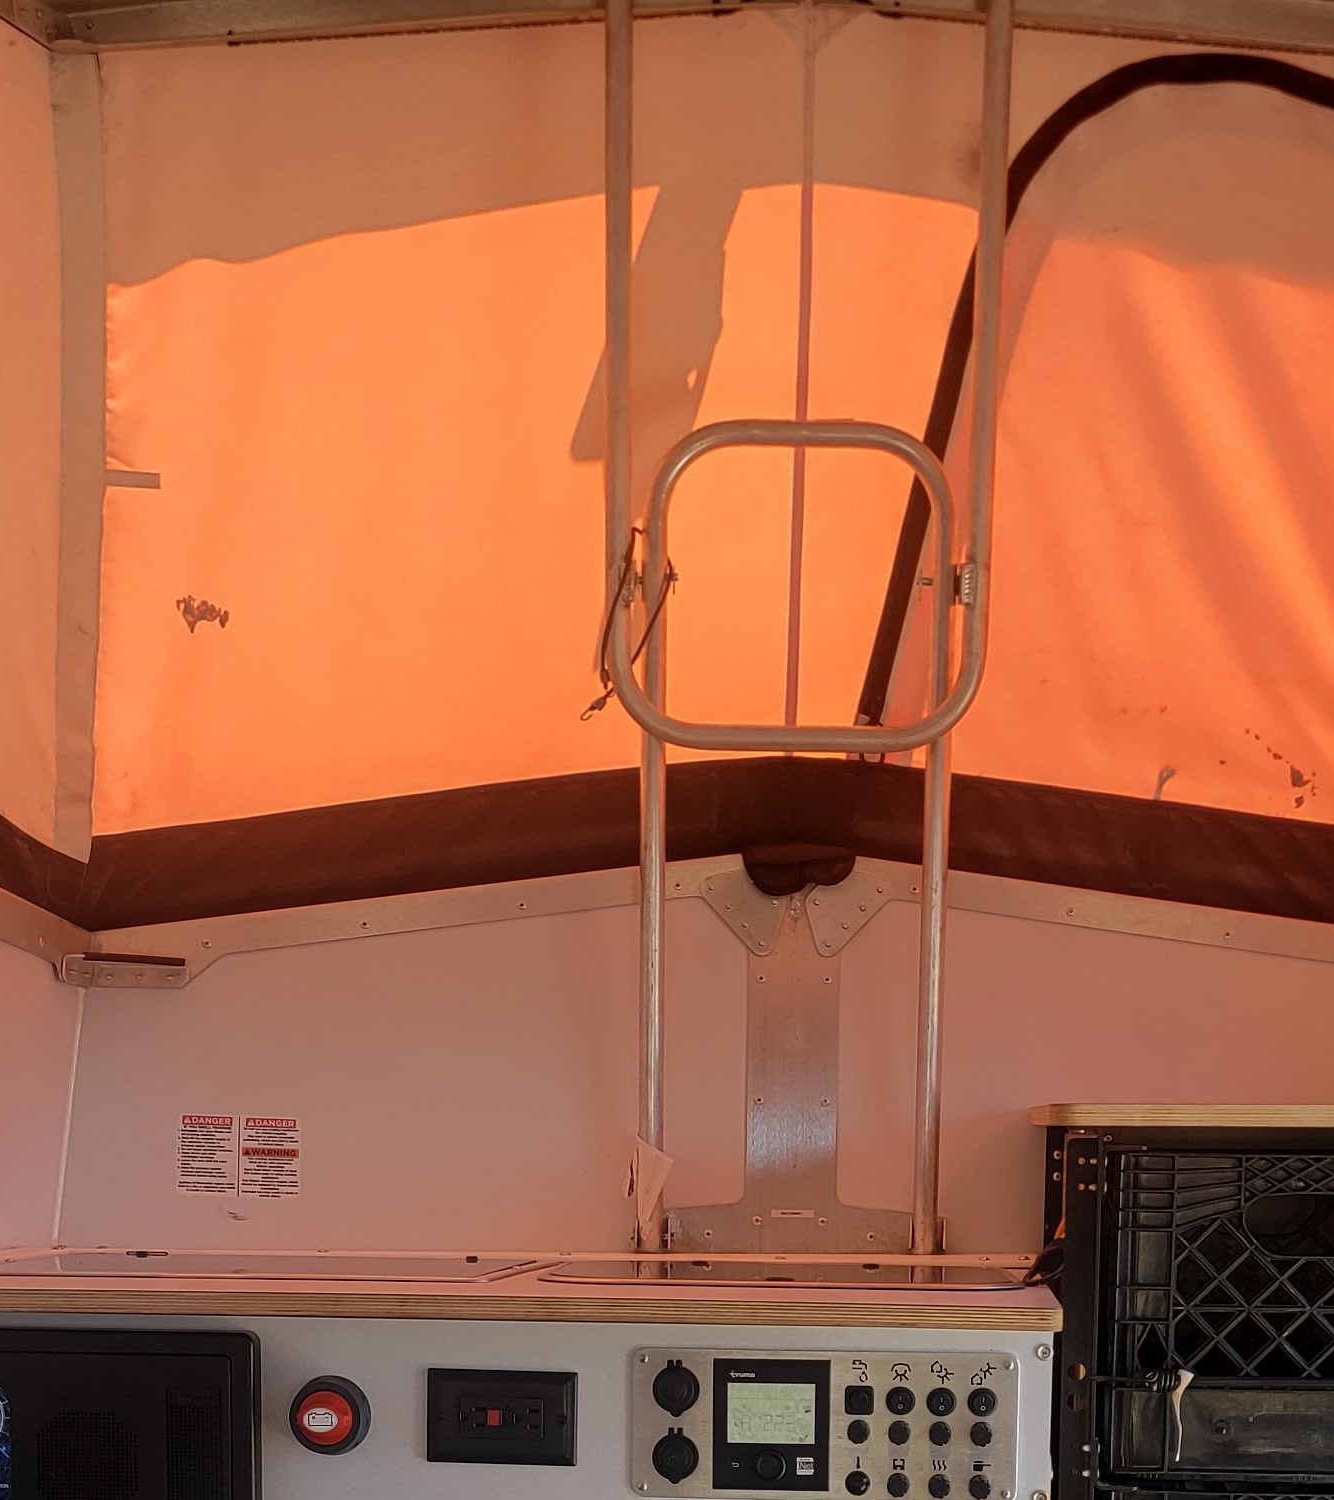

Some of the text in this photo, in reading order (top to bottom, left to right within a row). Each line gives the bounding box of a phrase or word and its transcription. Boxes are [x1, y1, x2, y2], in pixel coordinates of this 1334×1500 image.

[192, 1117, 231, 1125] DANGER
[255, 1120, 295, 1128] DANGER
[250, 1148, 296, 1157] WARNING
[730, 1370, 756, 1378] truma
